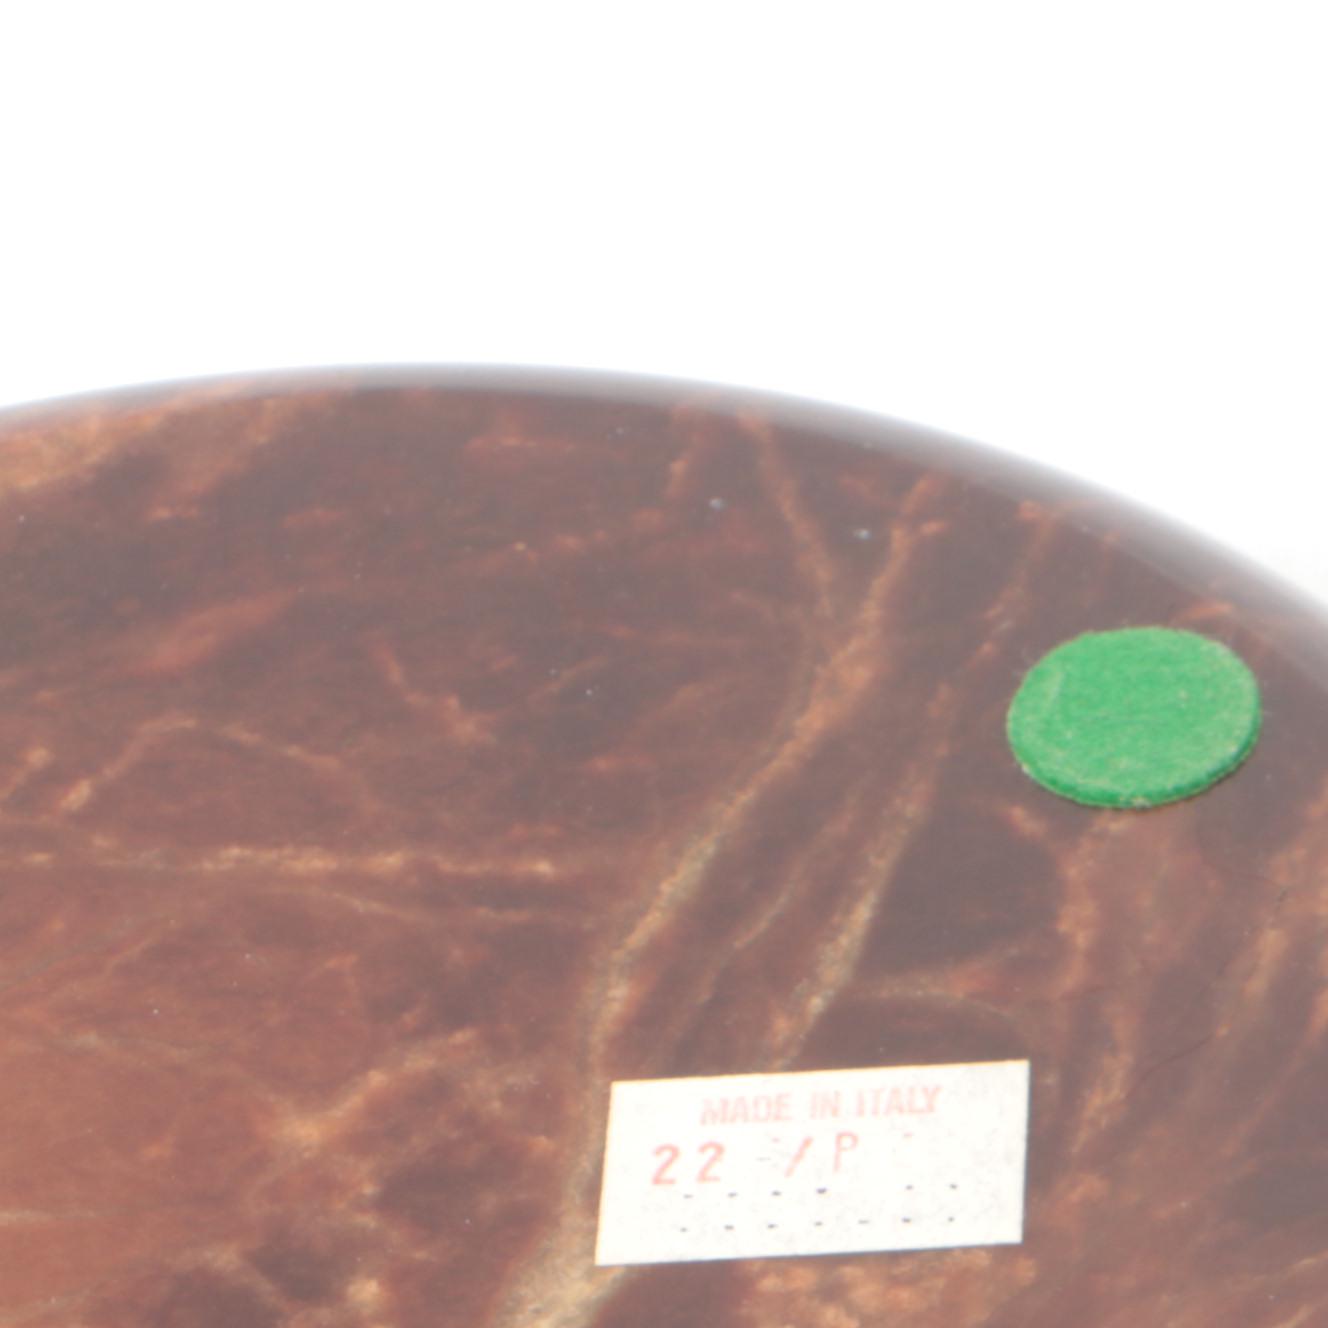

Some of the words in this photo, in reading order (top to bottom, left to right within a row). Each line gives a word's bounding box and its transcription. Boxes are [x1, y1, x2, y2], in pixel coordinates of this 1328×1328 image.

[700, 1092, 793, 1126] MADE
[810, 1089, 842, 1120] IN
[855, 1085, 943, 1119] ITALY
